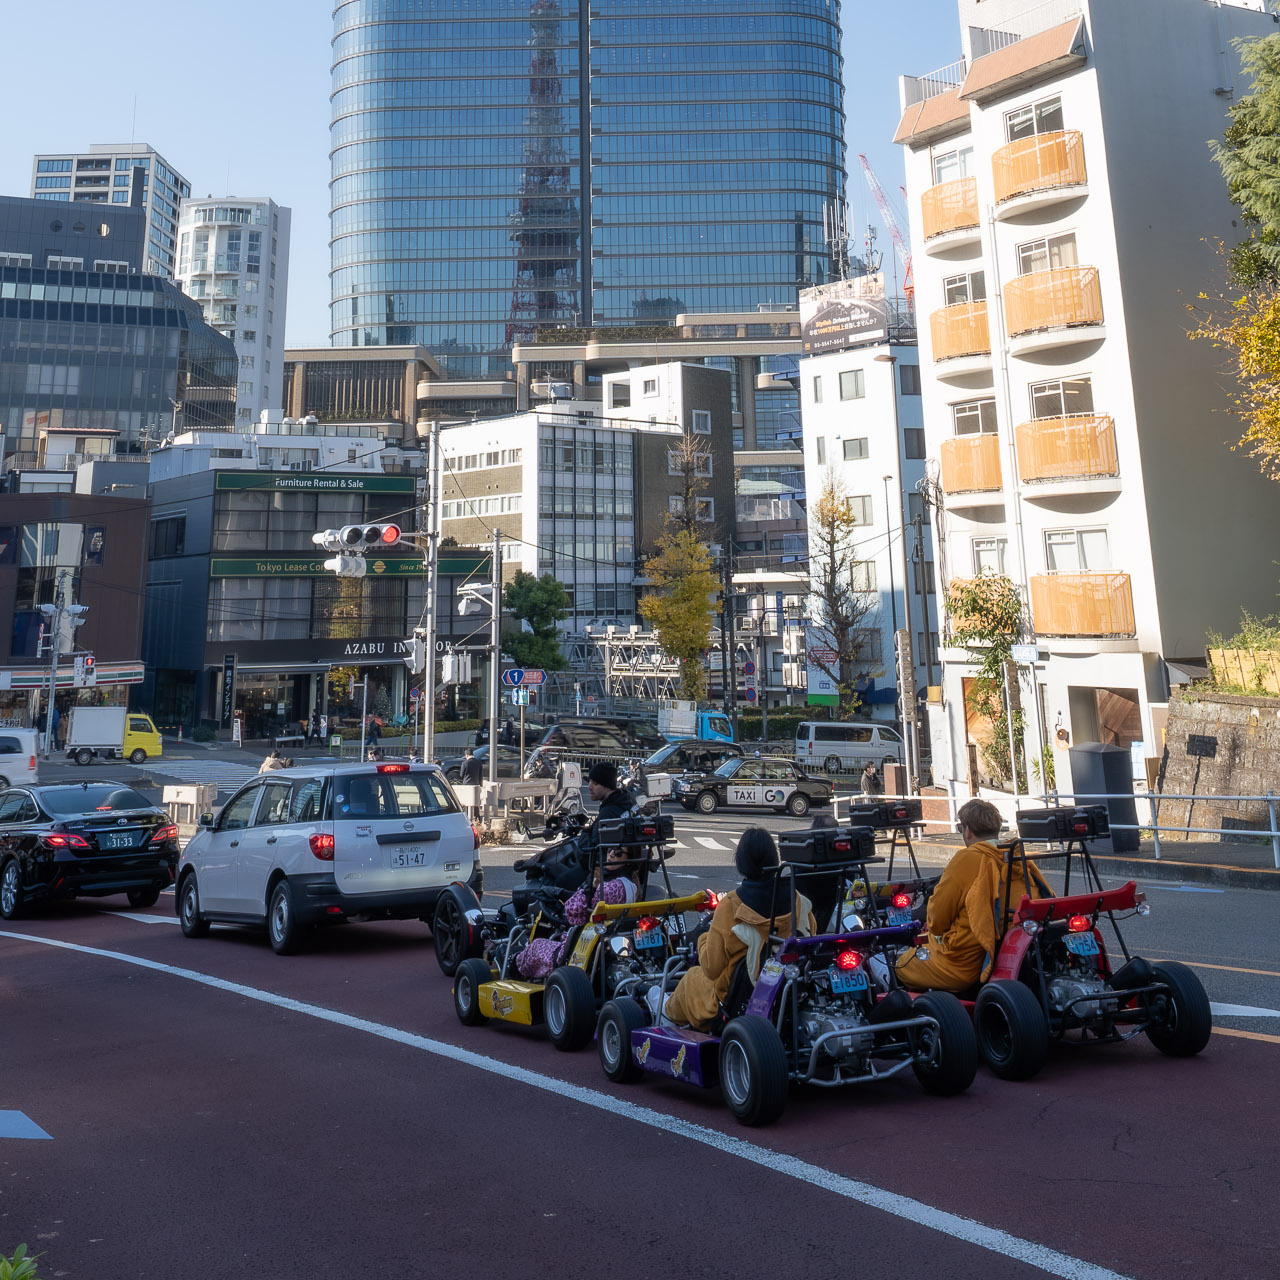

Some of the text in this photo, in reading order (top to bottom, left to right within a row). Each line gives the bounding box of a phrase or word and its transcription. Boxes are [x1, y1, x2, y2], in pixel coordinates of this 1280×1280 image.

[275, 478, 364, 488] Furniture Rental & Sale
[256, 562, 282, 573] Tokyo
[284, 562, 308, 572] Lease
[399, 563, 415, 571] Since
[322, 607, 360, 617] SALE
[344, 642, 385, 655] AZABU
[513, 671, 518, 682] 1
[734, 789, 785, 803] TAXI GO
[111, 837, 133, 848] 31-33
[399, 852, 425, 866] 51-47
[641, 932, 660, 946] 1787
[1075, 939, 1098, 953] 1754
[840, 972, 864, 989] 1850
